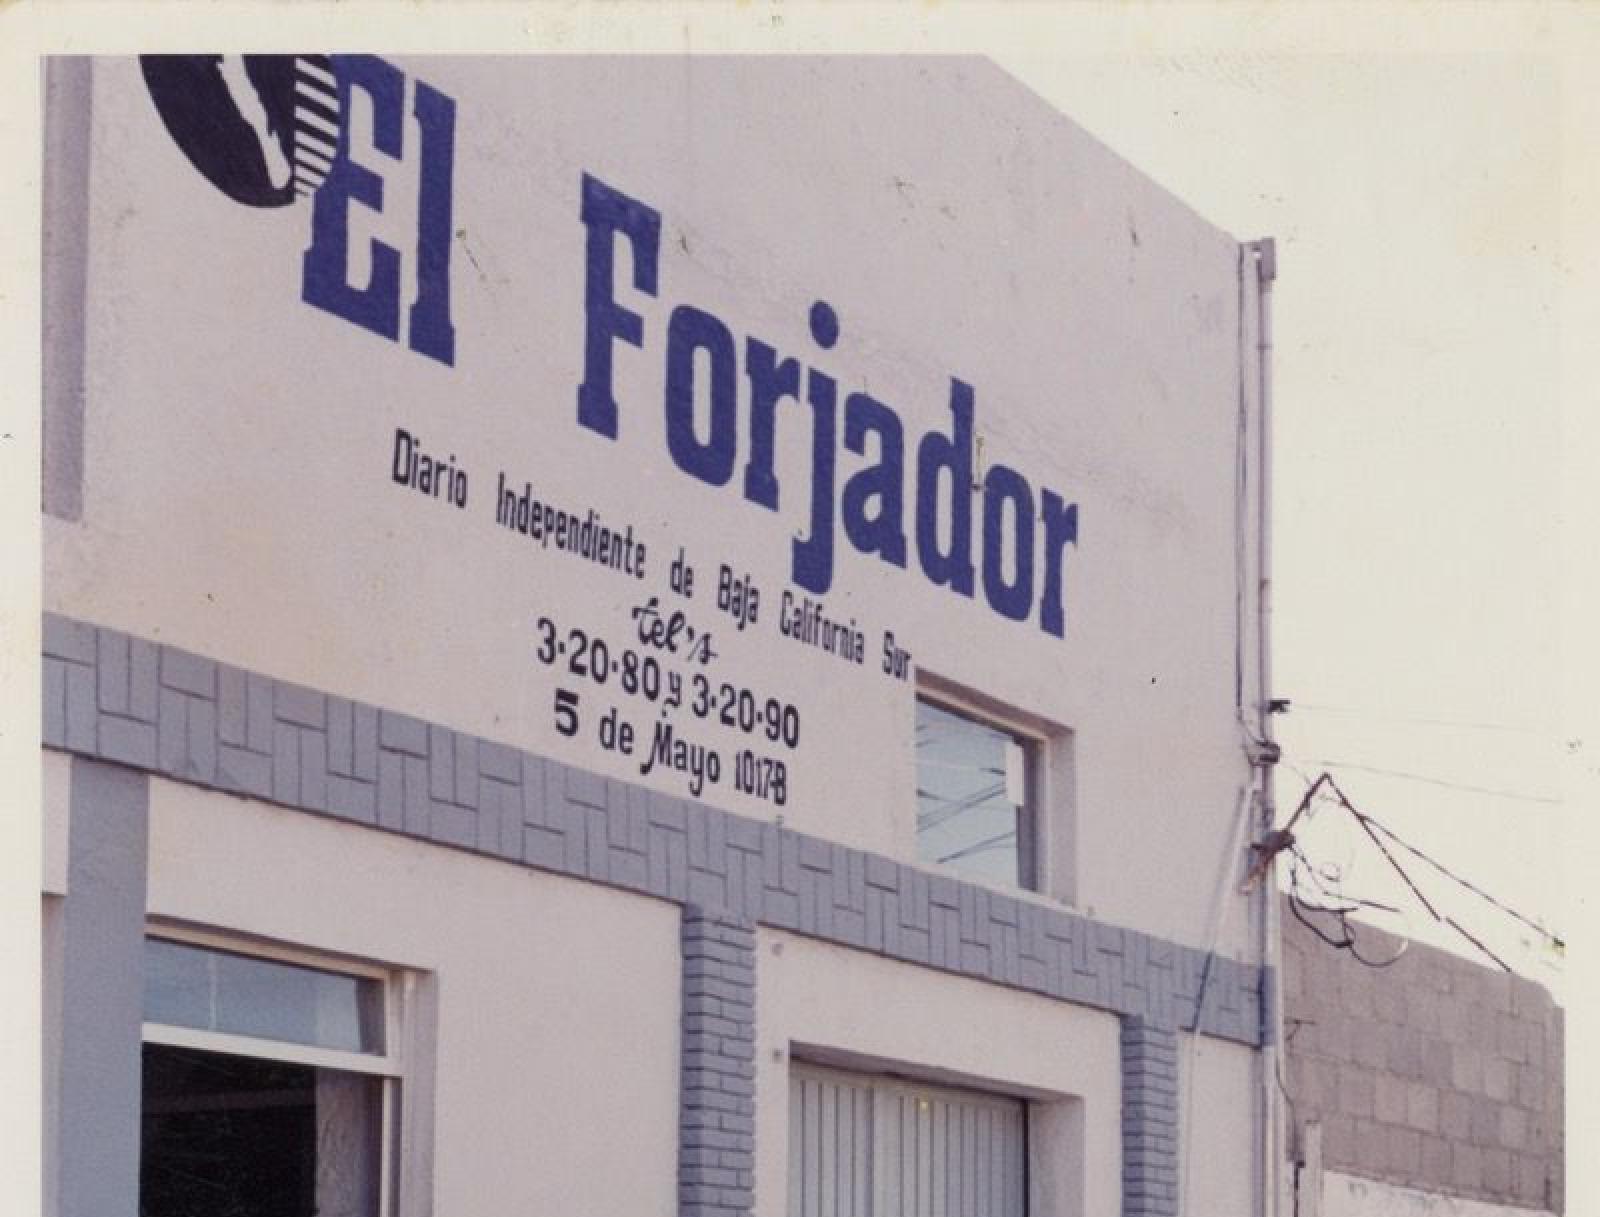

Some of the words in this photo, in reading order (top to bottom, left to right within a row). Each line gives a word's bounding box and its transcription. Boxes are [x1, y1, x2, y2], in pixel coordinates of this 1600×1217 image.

[301, 54, 456, 368] El
[577, 169, 1079, 640] Forjador
[391, 427, 468, 509] Diario
[495, 470, 647, 580] Independiente
[670, 546, 694, 599] de
[717, 563, 760, 632] Baja
[780, 589, 864, 665] California
[881, 630, 911, 681] Sur
[553, 686, 580, 738] 5
[598, 705, 635, 755] de
[639, 720, 721, 798] Mayo
[662, 670, 682, 718] y
